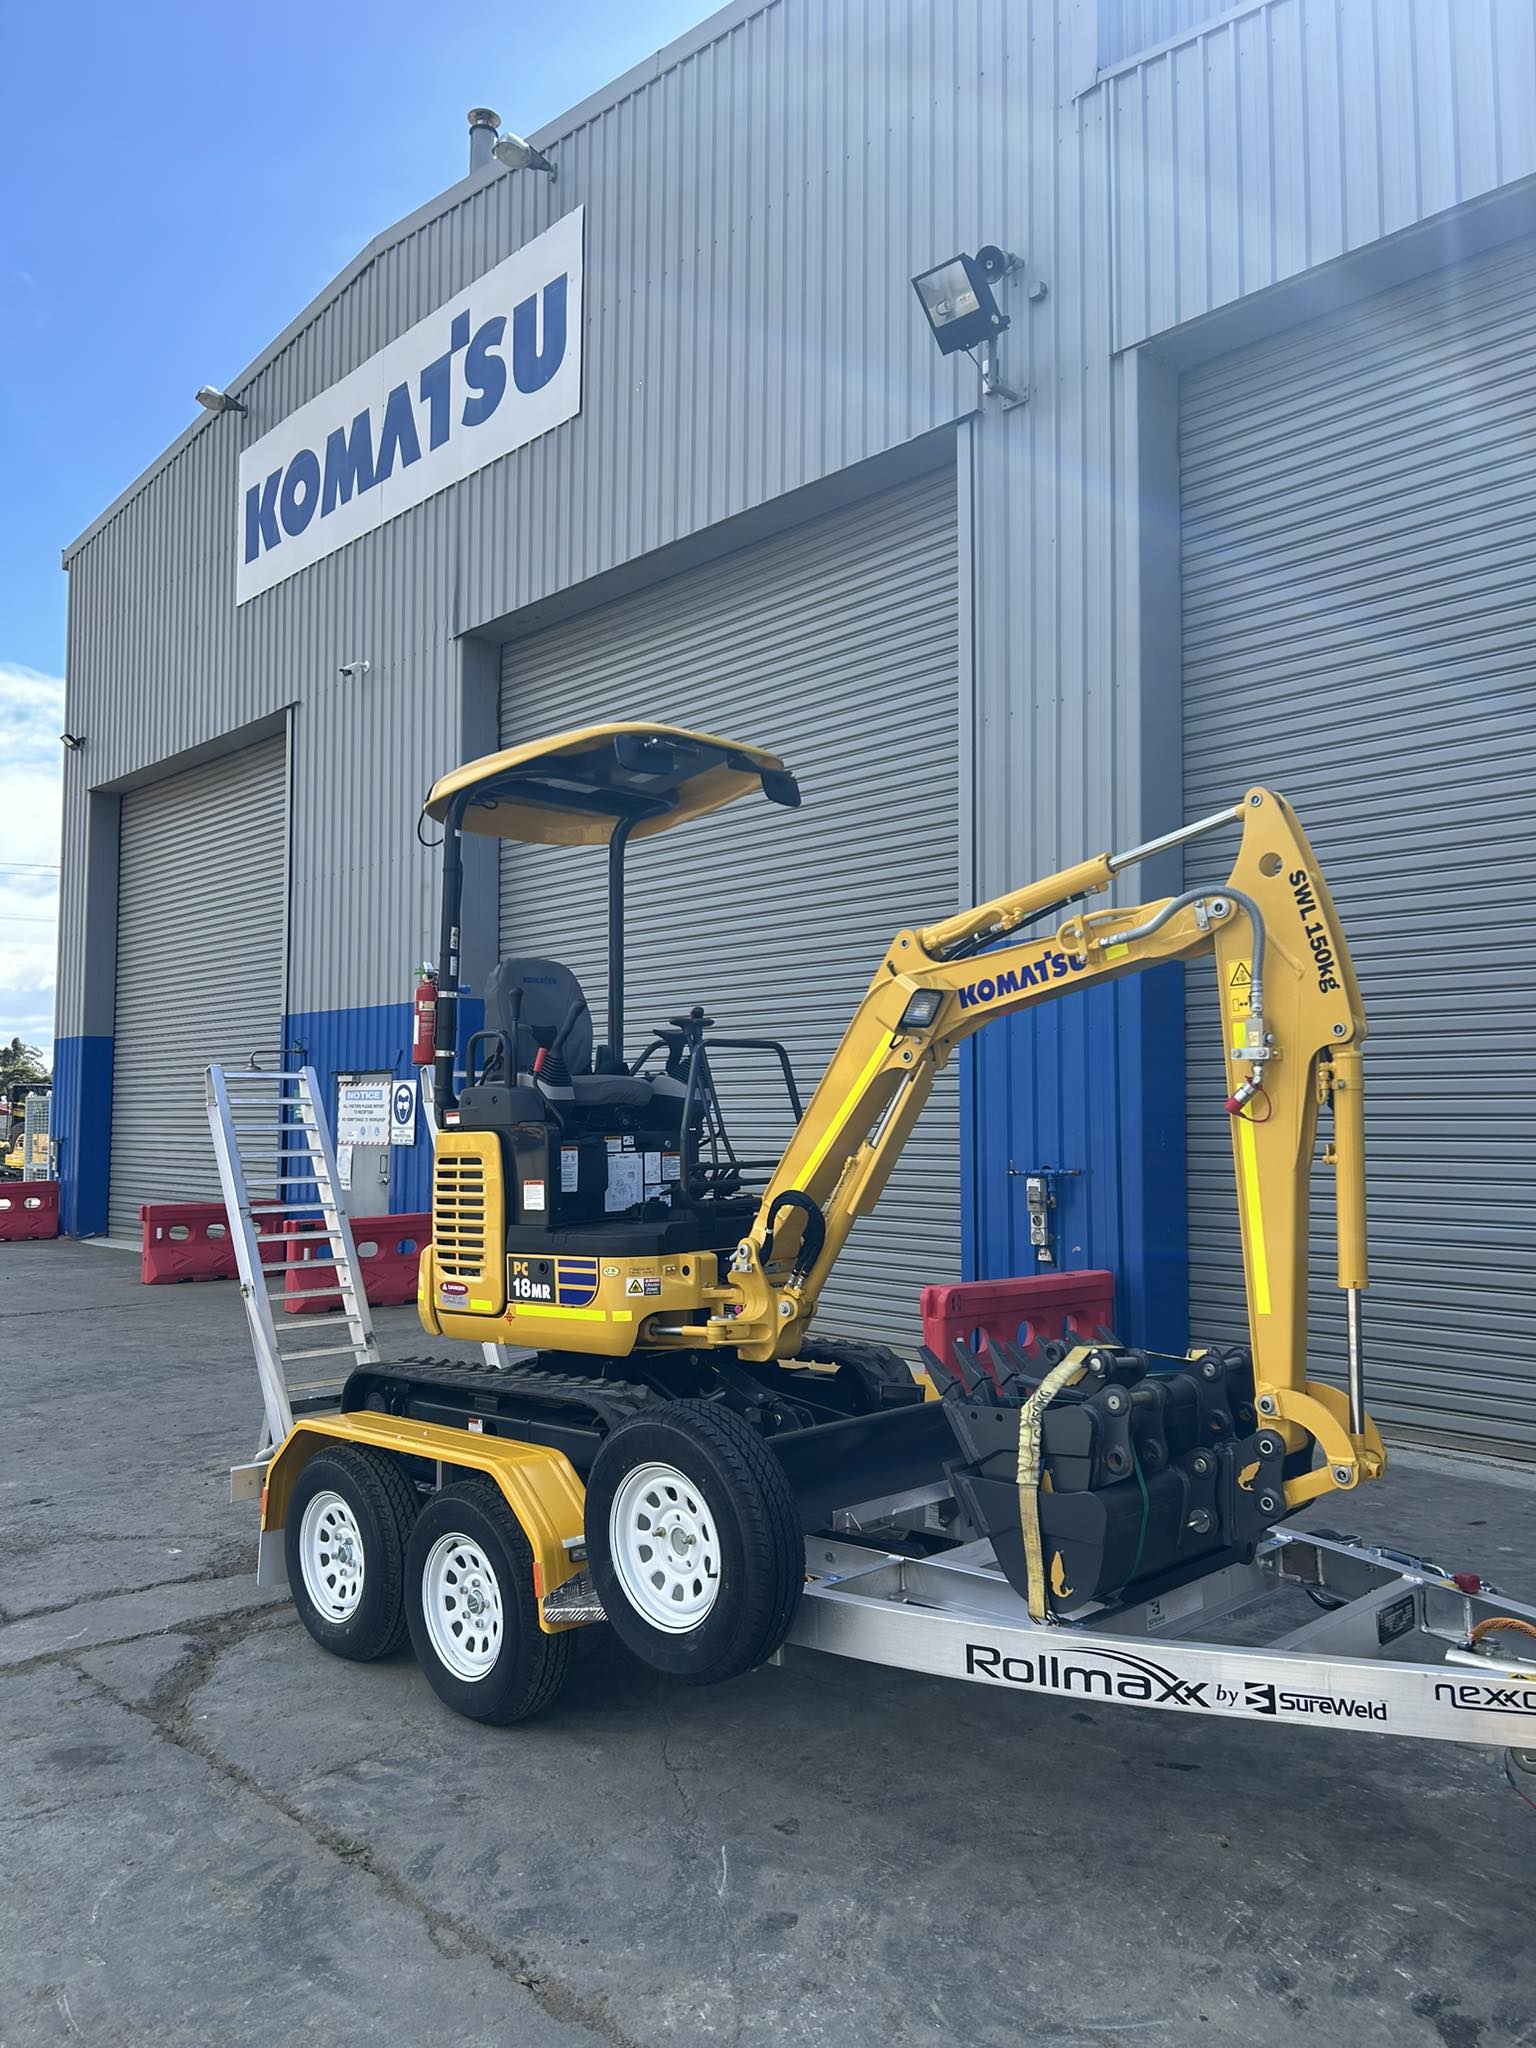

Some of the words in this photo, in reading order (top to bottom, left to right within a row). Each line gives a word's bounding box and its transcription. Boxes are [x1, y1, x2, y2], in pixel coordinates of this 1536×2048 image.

[245, 271, 568, 565] KOMATSU
[1289, 869, 1317, 921] SWL
[1304, 921, 1341, 994] 150kg
[958, 950, 1087, 1009] KOMATSU
[347, 1091, 381, 1100] NOTICE
[513, 1261, 529, 1276] PC
[513, 1277, 552, 1300] 18MR
[966, 1643, 1212, 1708] Rollmaxx
[1216, 1684, 1239, 1706] by
[1279, 1692, 1388, 1721] SureWeld
